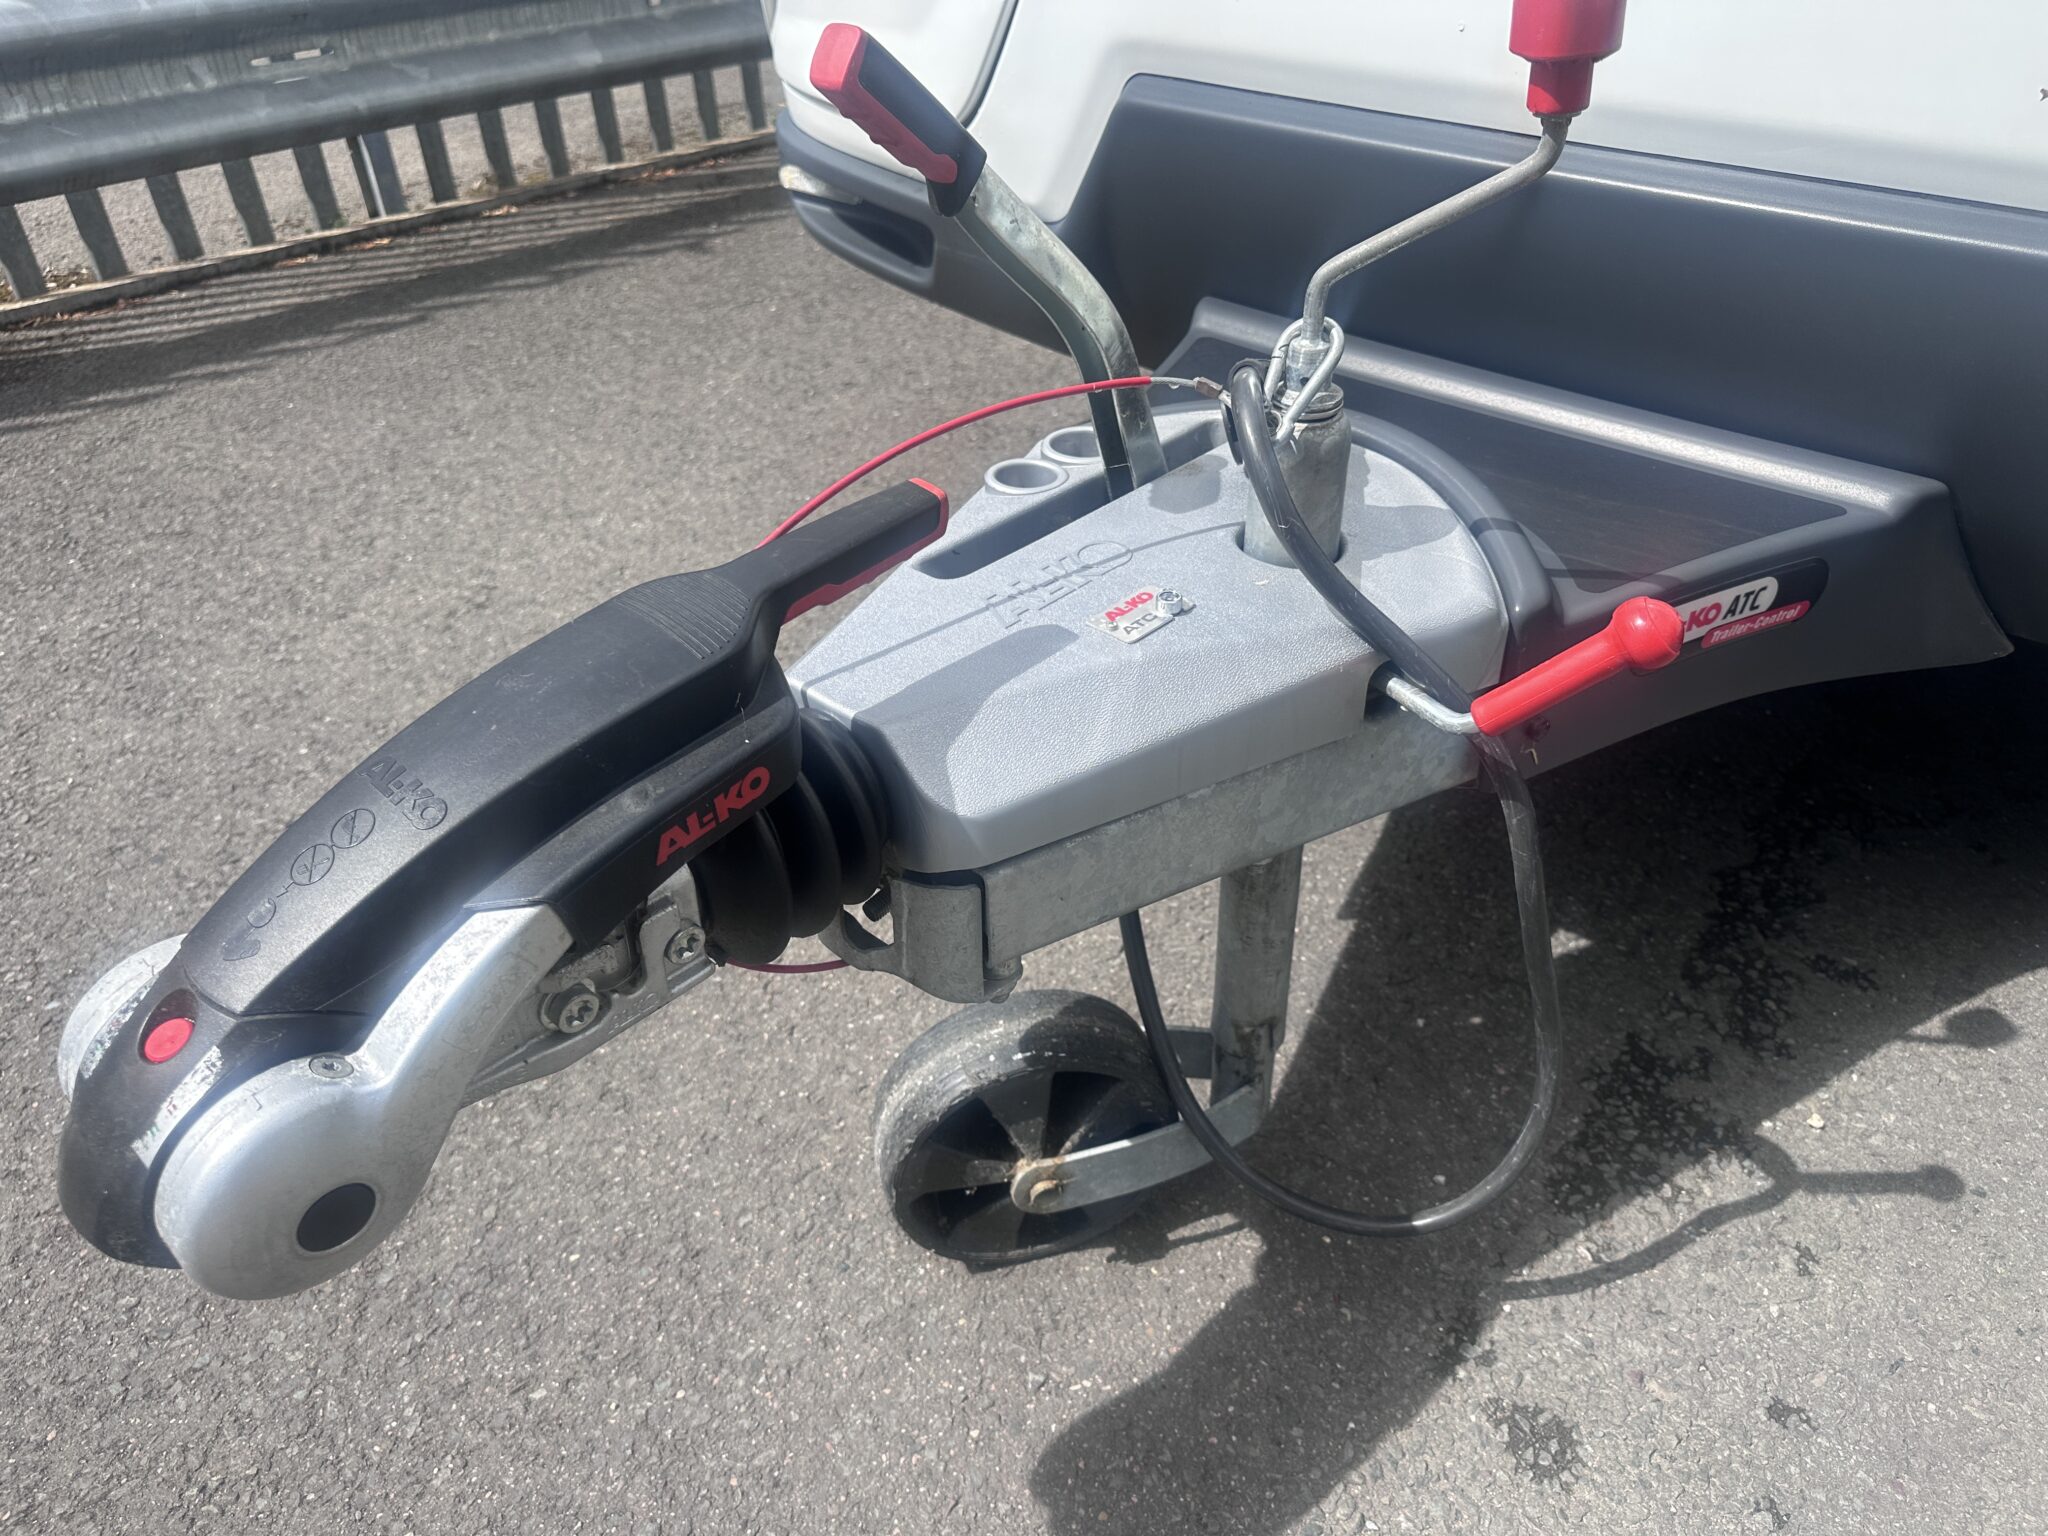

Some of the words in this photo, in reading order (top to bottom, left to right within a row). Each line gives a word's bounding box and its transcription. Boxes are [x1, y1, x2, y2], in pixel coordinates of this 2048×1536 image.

[1105, 592, 1153, 622] AL-KO
[1722, 586, 1768, 620] ATC
[1123, 613, 1158, 634] ATC
[1711, 606, 1801, 643] Trailer-Control
[357, 757, 448, 830] AL-KO
[656, 767, 770, 866] AL-KO
